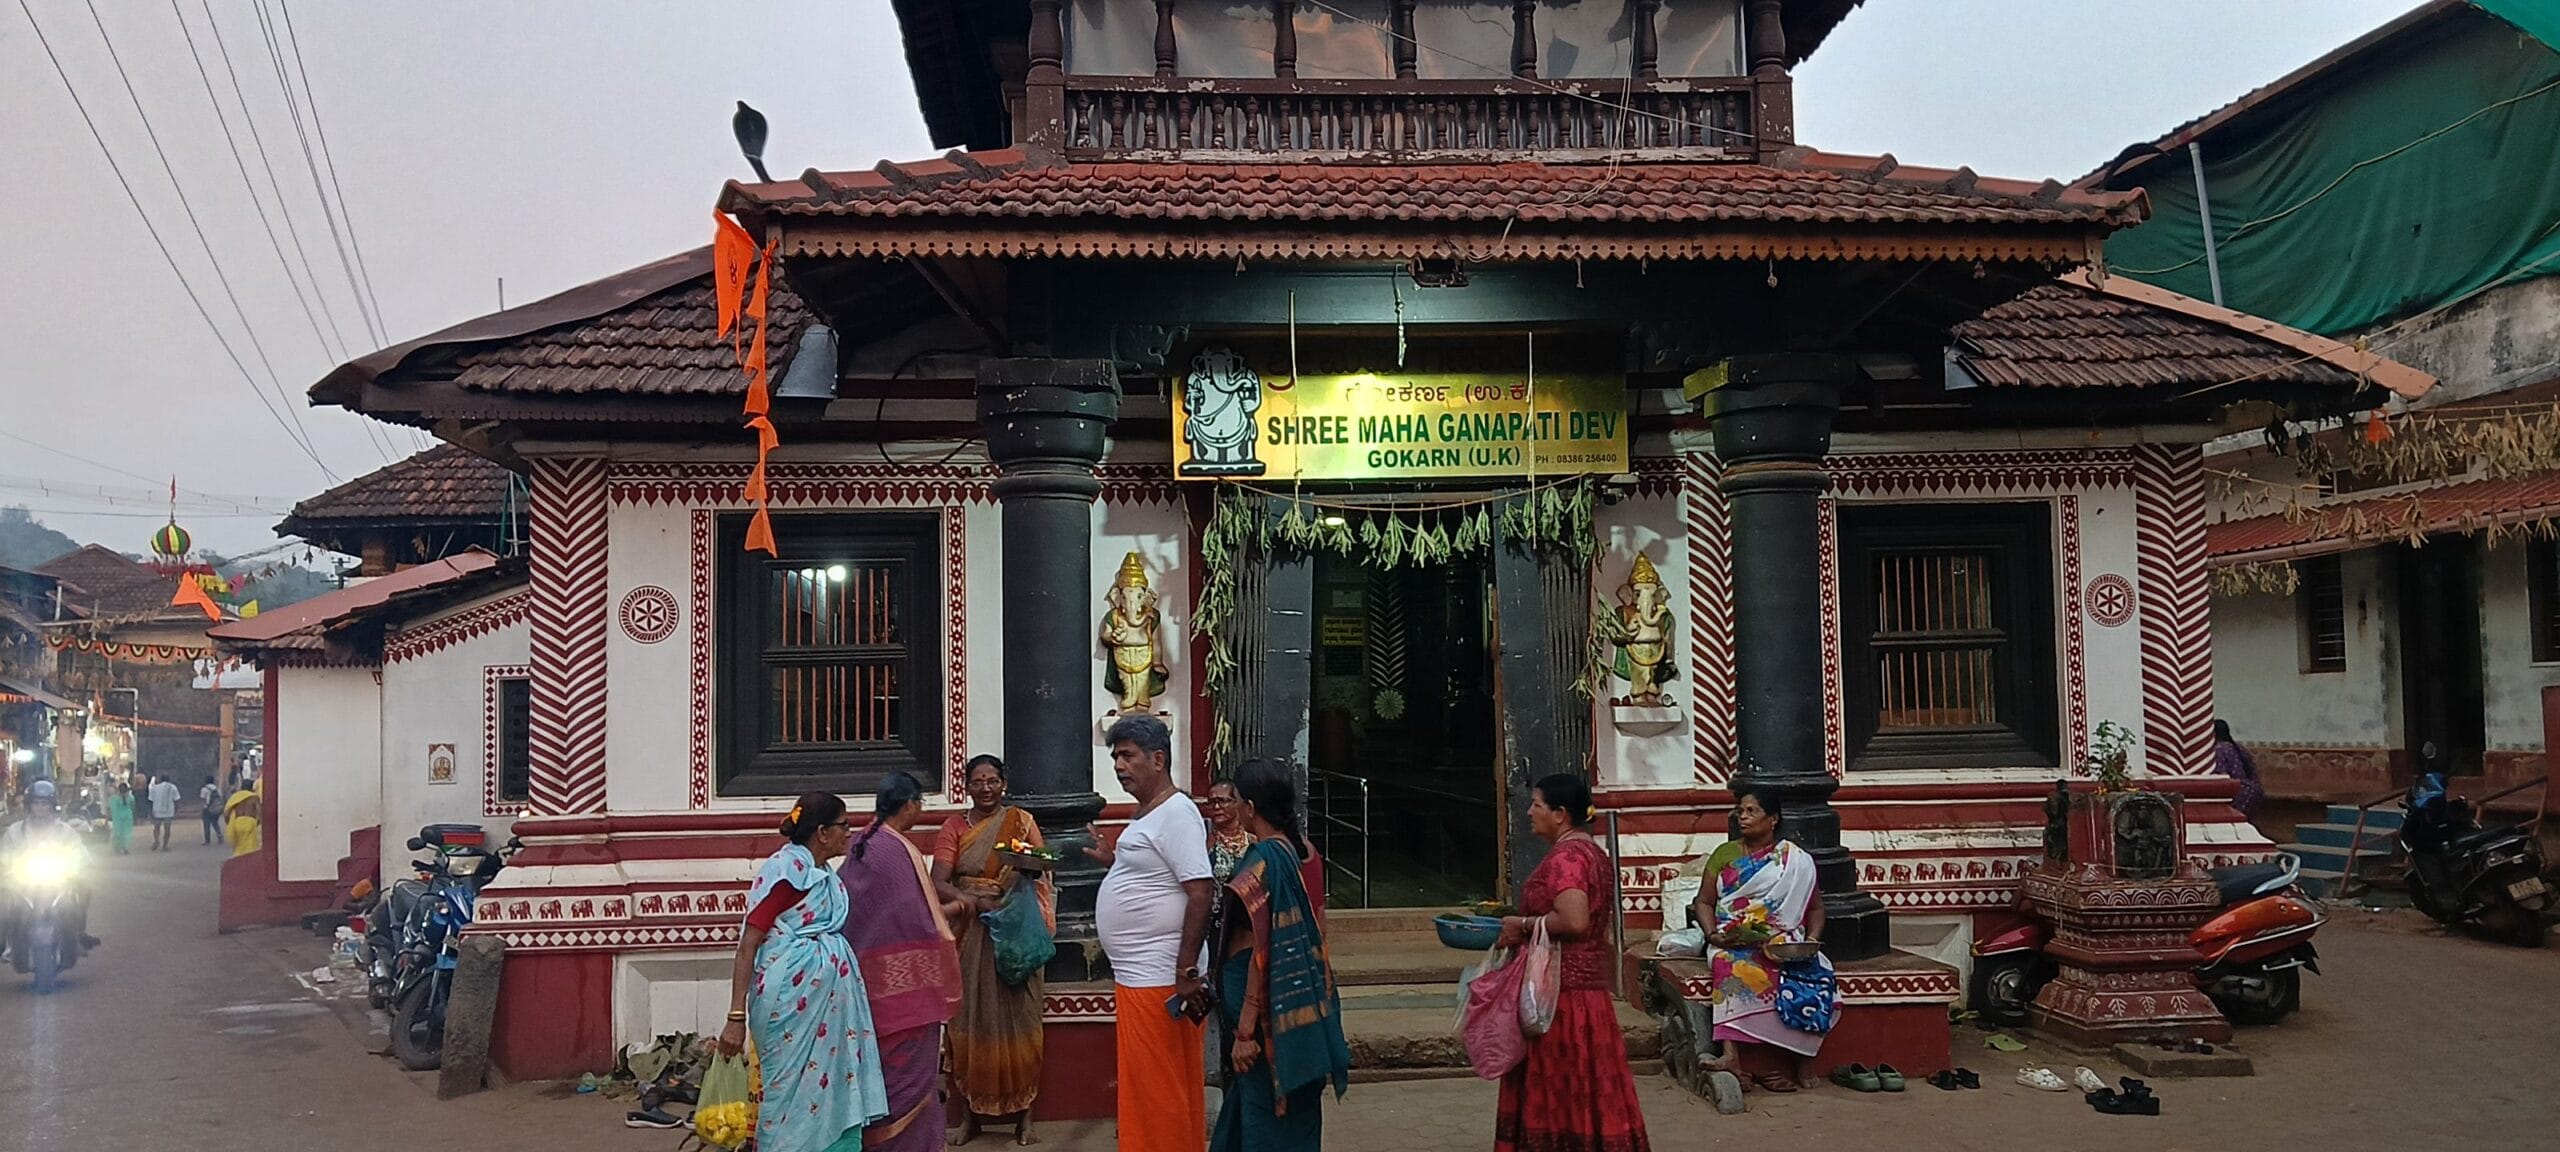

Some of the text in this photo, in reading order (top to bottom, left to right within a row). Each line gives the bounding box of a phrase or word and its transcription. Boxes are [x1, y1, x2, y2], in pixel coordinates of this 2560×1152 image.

[1267, 411, 1618, 446] SHREE MAHA GANAPATI DEV
[1367, 446, 1521, 468] GOKARN (U.K)
[1557, 454, 1583, 463] 08386
